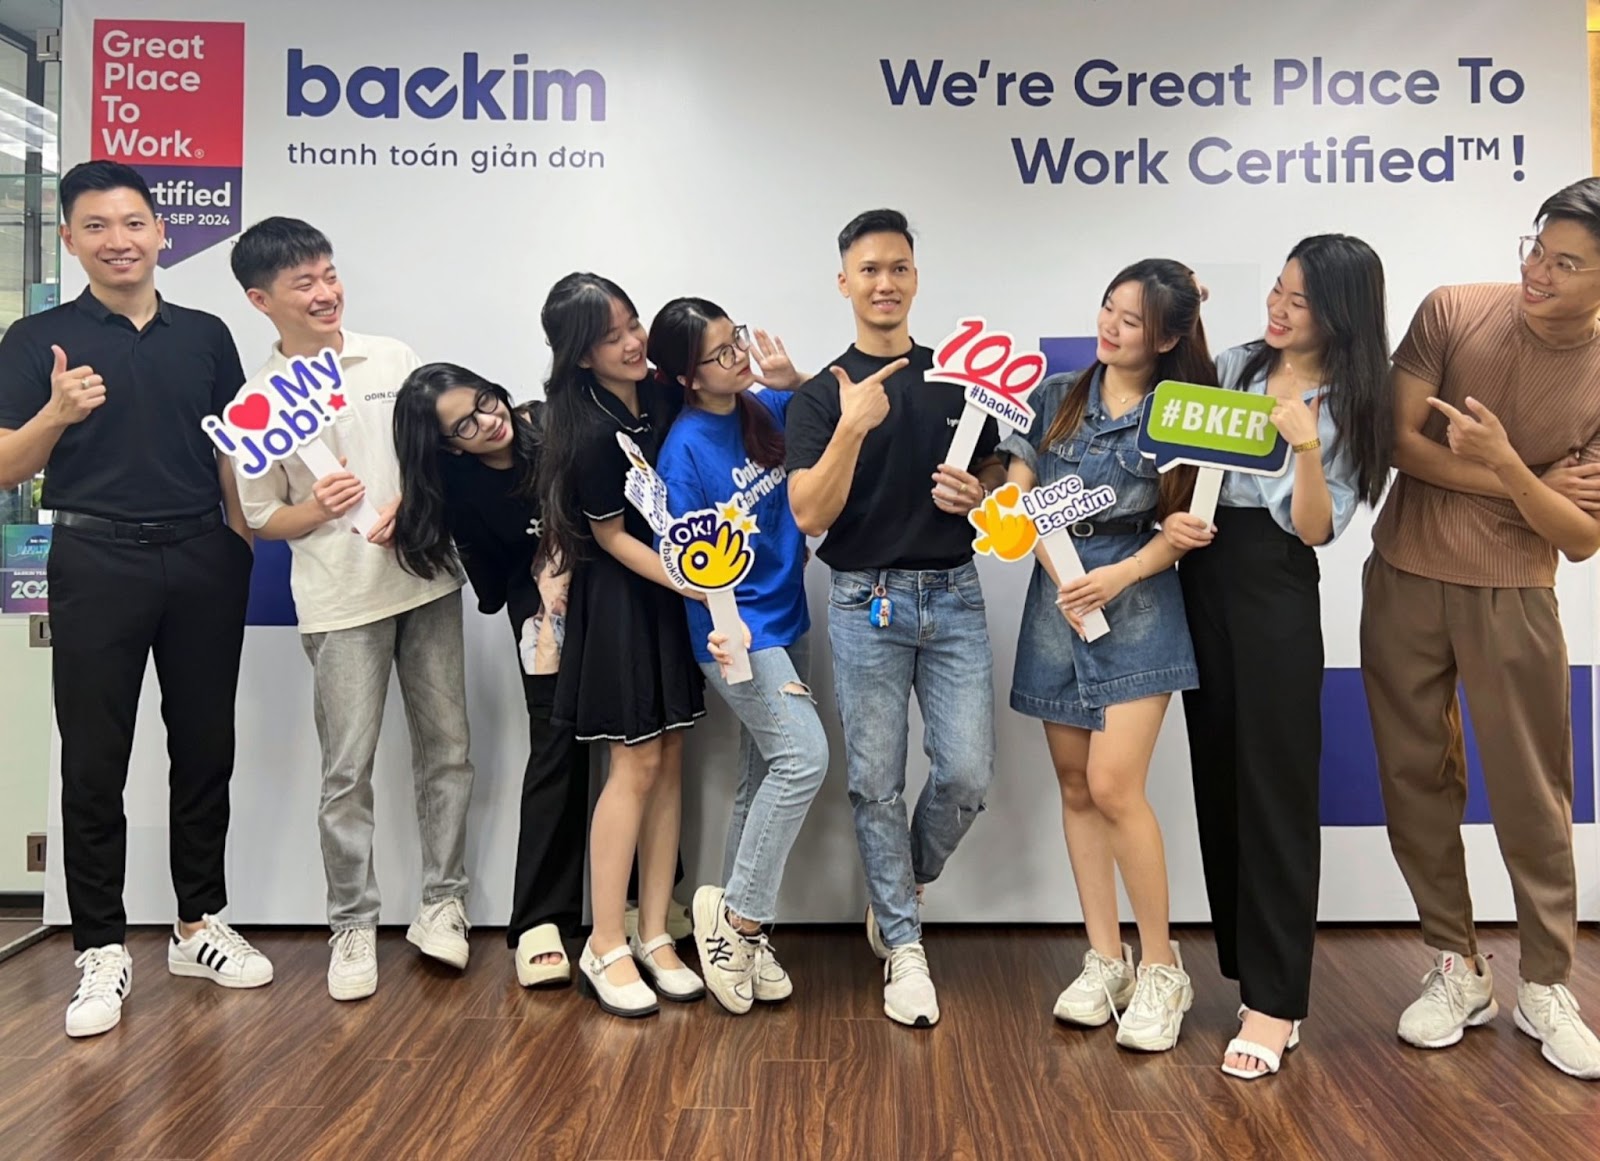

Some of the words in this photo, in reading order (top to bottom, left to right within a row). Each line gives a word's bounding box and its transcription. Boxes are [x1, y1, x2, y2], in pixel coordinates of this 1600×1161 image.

[102, 30, 204, 59] Great
[105, 62, 201, 91] Place
[287, 48, 606, 122] baokim
[879, 58, 1054, 107] We're
[1074, 58, 1251, 107] Great
[1273, 56, 1440, 106] Place
[1458, 57, 1525, 104] To
[101, 95, 140, 123] To
[287, 142, 377, 166] thanh
[390, 142, 458, 167] toán
[471, 143, 537, 174] giản
[548, 146, 605, 168] đơn
[1010, 137, 1170, 185] Work
[198, 214, 230, 226] 2024
[936, 320, 1044, 394] 100
[206, 420, 237, 452] i
[269, 351, 342, 407] My
[969, 385, 1029, 429] #baokim
[1161, 398, 1269, 442] #BKER
[241, 398, 331, 475] Job!
[1022, 495, 1036, 516] i
[1034, 477, 1081, 509] love
[1033, 487, 1114, 536] Baokim
[674, 519, 713, 544] OK!
[663, 541, 686, 587] #baokim
